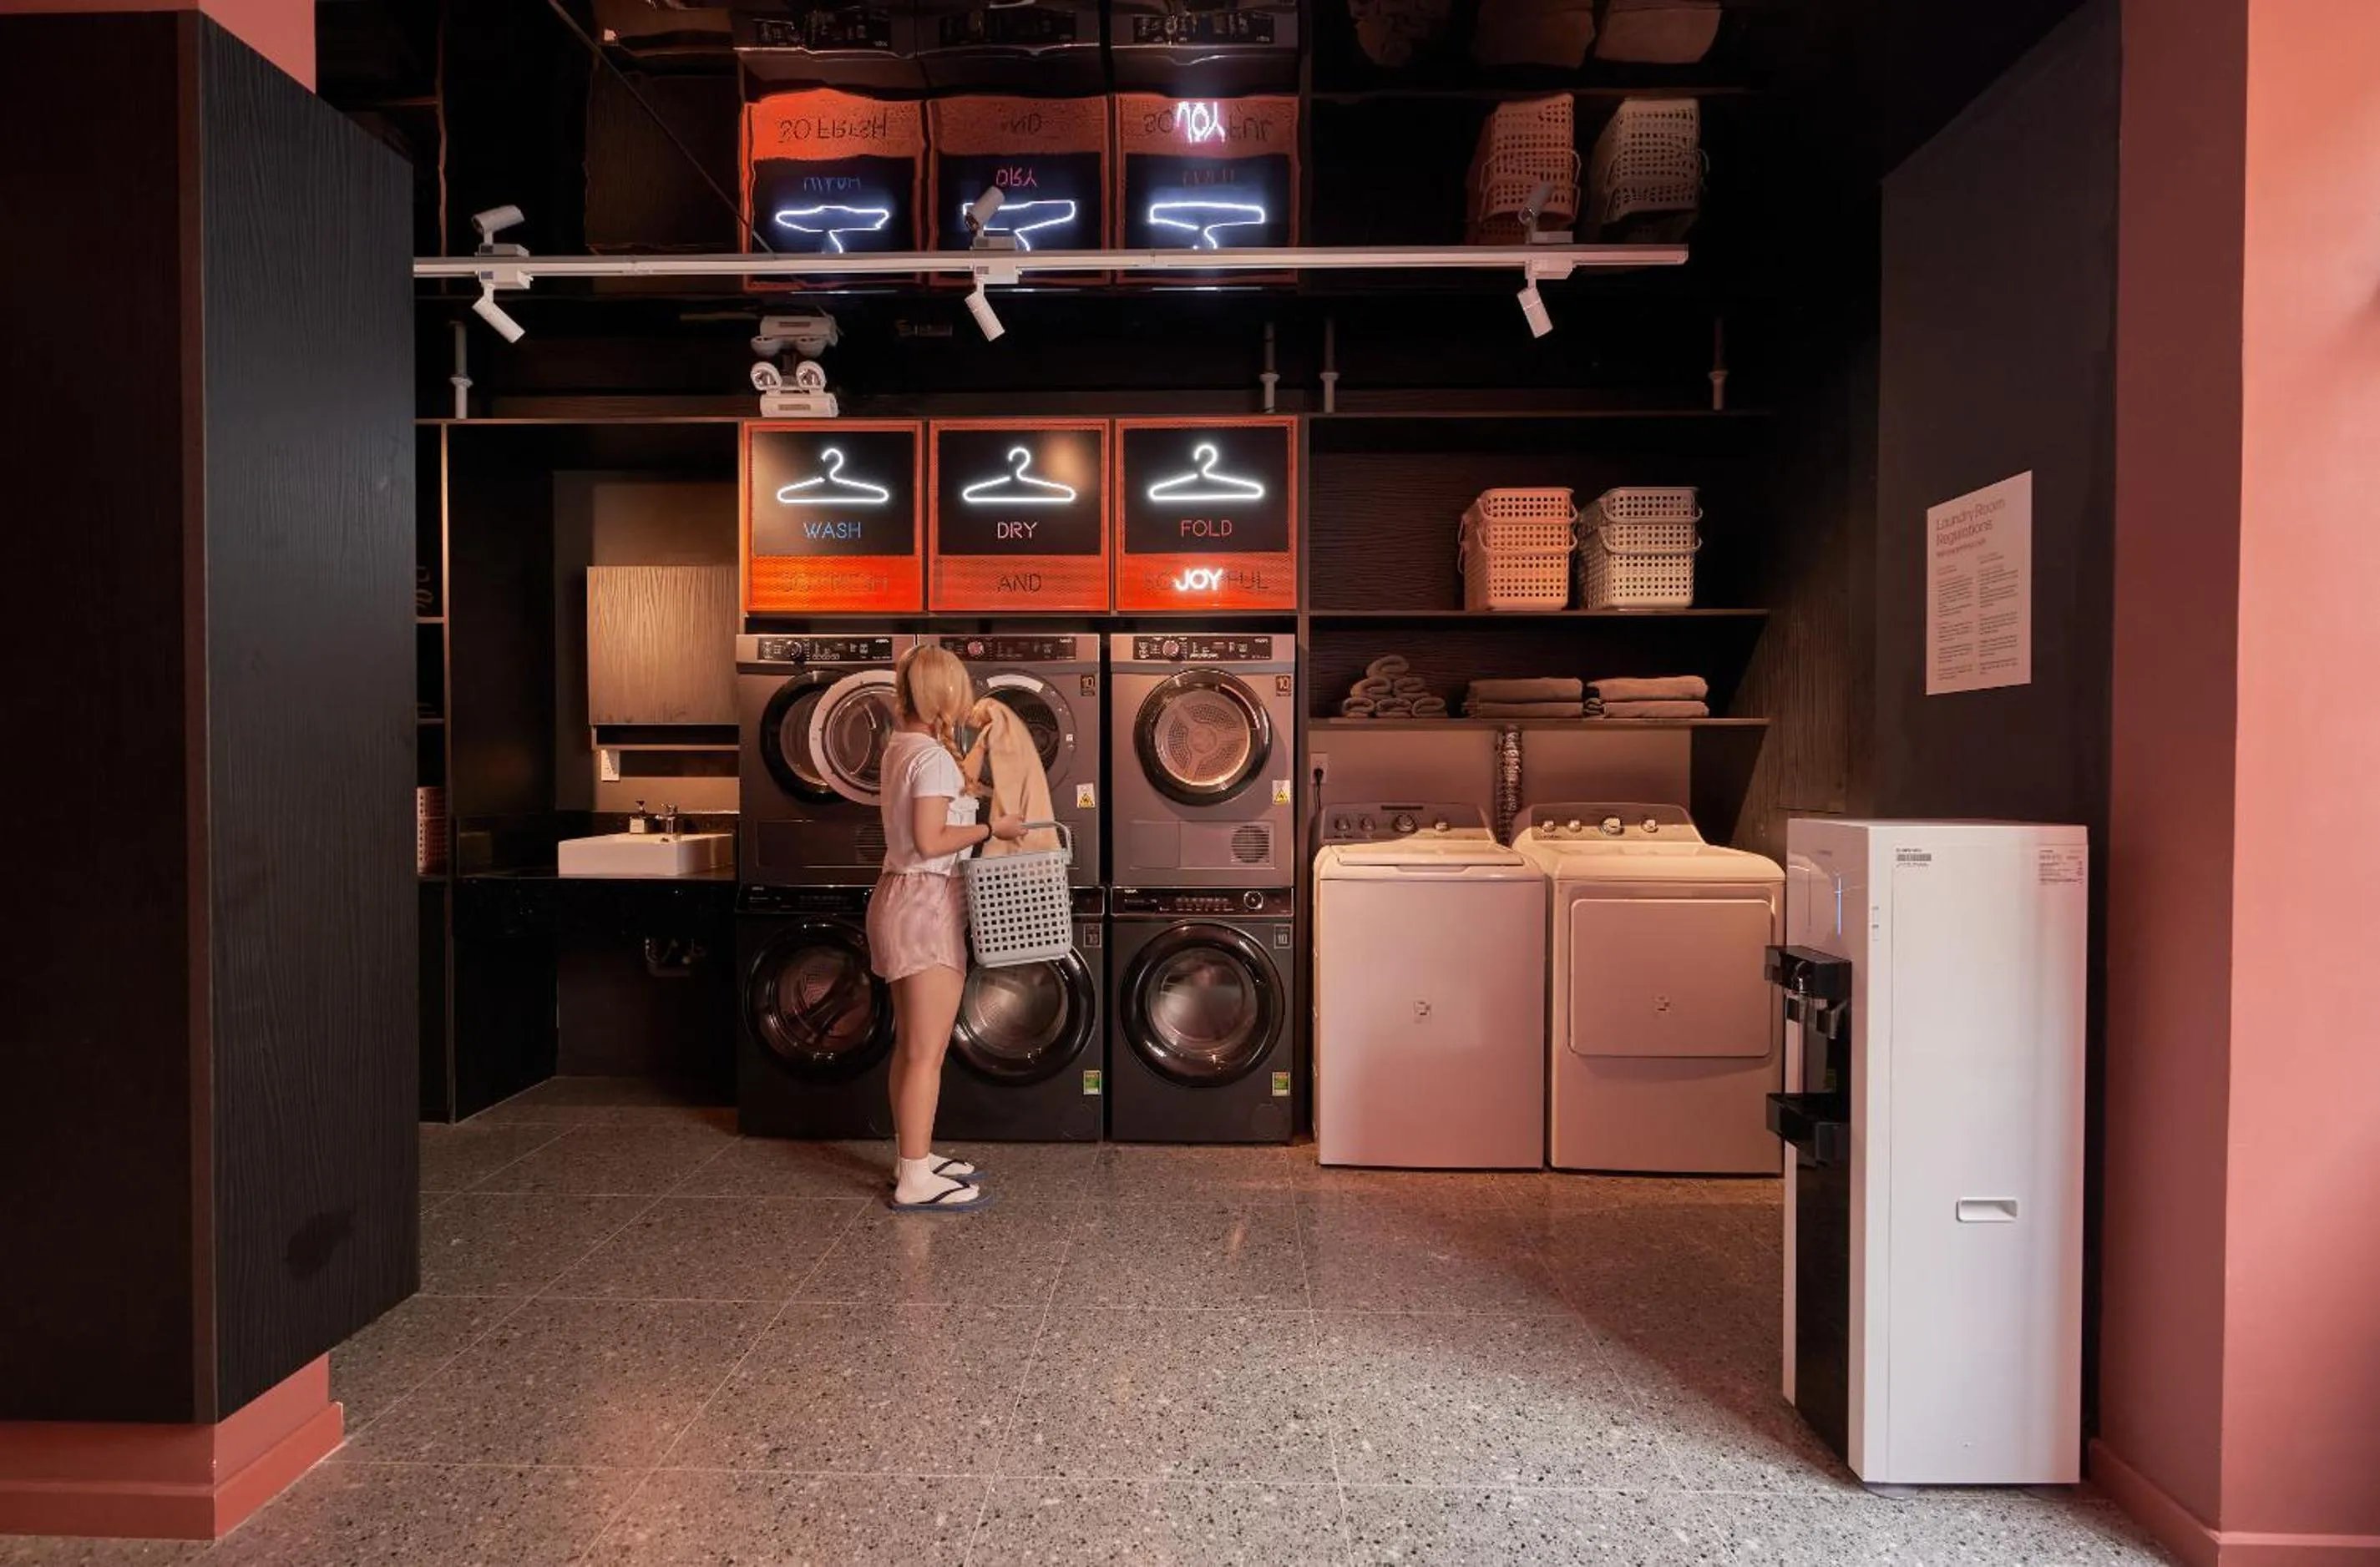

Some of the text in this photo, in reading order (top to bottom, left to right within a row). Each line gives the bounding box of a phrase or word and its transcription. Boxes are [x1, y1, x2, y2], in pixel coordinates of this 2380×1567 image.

[803, 521, 861, 539] WASH
[997, 521, 1037, 539] DRY
[1180, 519, 1233, 538] FOLD
[997, 574, 1042, 593] AND
